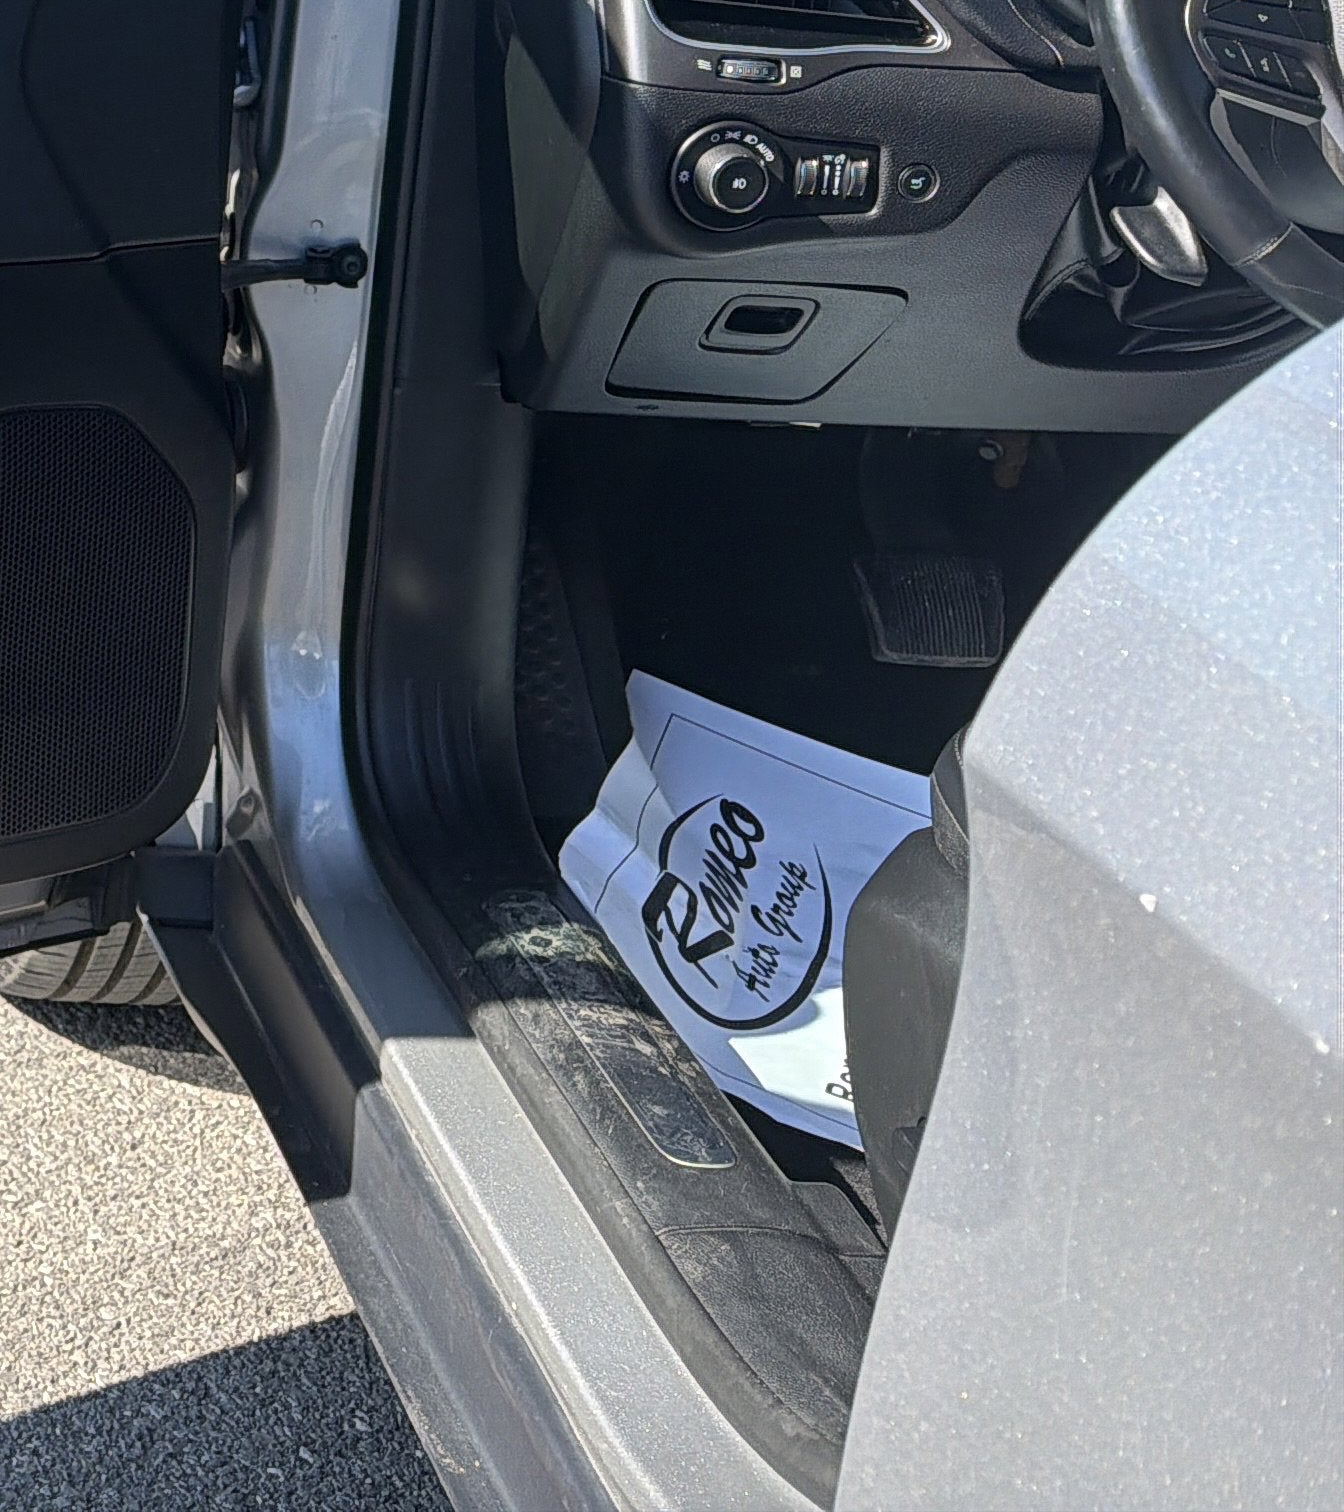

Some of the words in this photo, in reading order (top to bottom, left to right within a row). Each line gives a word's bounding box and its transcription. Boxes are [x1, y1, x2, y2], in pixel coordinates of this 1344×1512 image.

[756, 143, 775, 163] AUTO
[641, 798, 765, 989] Romeo
[750, 859, 817, 944] Group
[726, 943, 781, 1003] Auto
